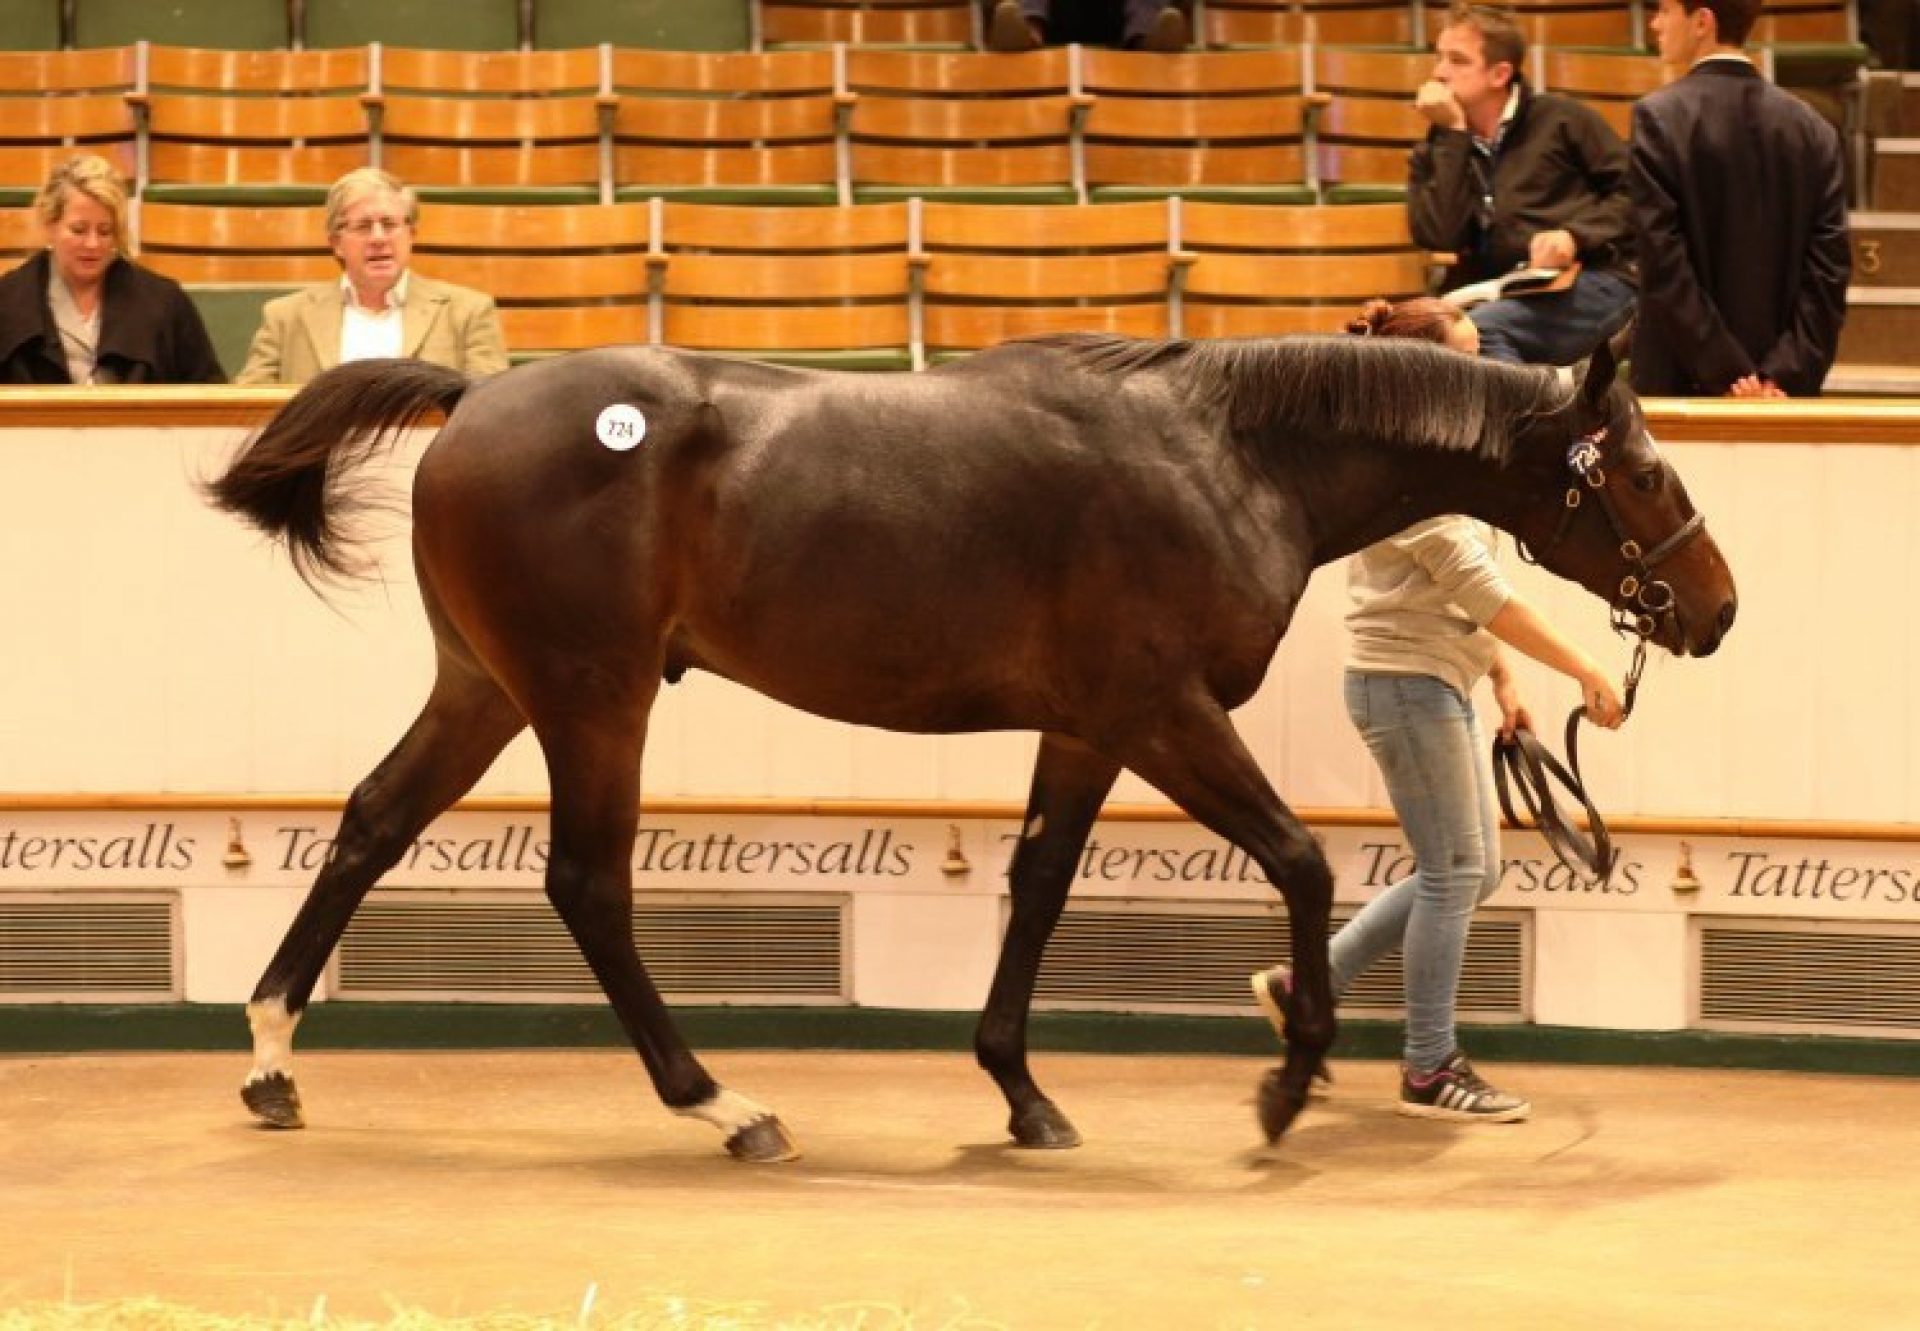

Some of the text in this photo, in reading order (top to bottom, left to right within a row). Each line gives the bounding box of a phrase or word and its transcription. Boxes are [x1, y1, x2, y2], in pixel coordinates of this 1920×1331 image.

[1859, 240, 1881, 273] 3
[608, 419, 633, 438] 724
[276, 825, 551, 872] Tarsalls
[635, 828, 915, 876] Tattersalls
[1727, 851, 1920, 902] Tatters
